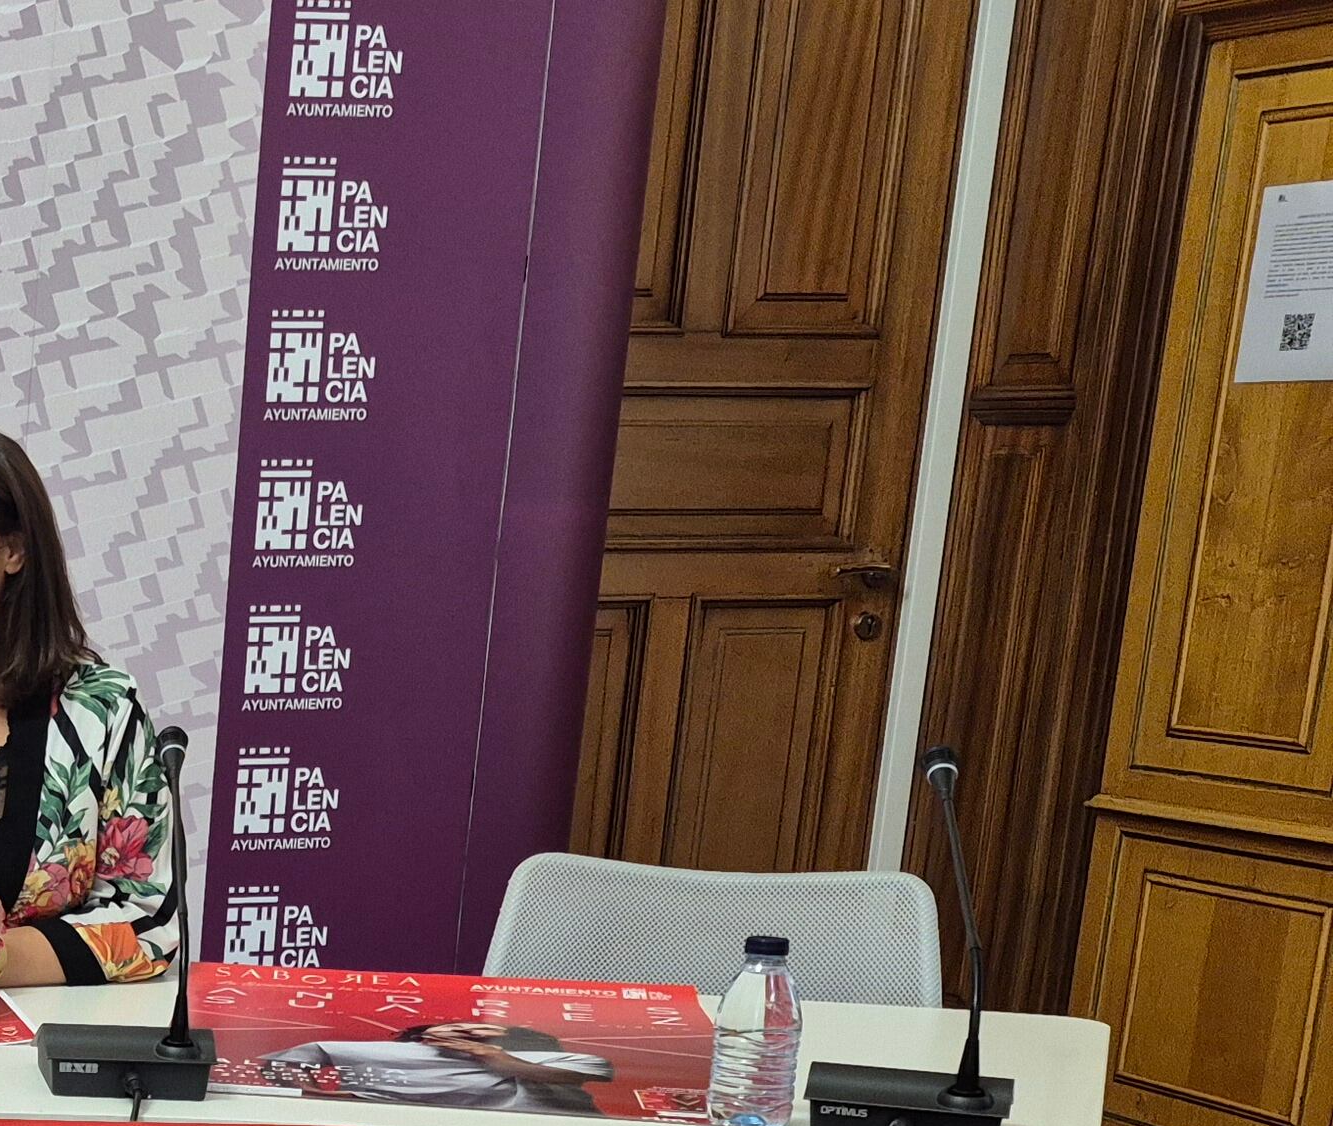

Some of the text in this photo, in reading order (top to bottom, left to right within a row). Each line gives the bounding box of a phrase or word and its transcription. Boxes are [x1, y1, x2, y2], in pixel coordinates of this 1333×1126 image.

[355, 25, 388, 48] PA
[353, 50, 404, 74] LEN
[350, 76, 394, 99] CIA
[287, 103, 393, 118] AYUNTAMIENTO
[341, 181, 373, 203] PA
[338, 205, 388, 229] LEN
[336, 230, 380, 252] CIA
[275, 258, 379, 272] AYUNTAMIENTO
[329, 332, 361, 355] PA
[327, 356, 375, 379] LEN
[324, 381, 368, 403] CIA
[263, 408, 367, 421] AYUNTAMIENTO
[316, 481, 349, 502] PA
[314, 504, 363, 526] LEN
[313, 528, 355, 550] CIA
[252, 554, 354, 568] AYUNTAMIENTO
[305, 626, 336, 647] PA
[303, 648, 351, 670] LEN
[301, 671, 343, 693] CIA
[241, 697, 343, 712] AYUNTAMIENTO
[294, 767, 325, 788] PA
[292, 789, 339, 811] LEN
[290, 812, 332, 832] CIA
[231, 836, 331, 851] AYUNTAMIENTO
[283, 905, 314, 925] PA
[281, 926, 328, 947] LEN
[279, 948, 321, 968] CIA
[470, 984, 617, 997] AYUNTAMIENTO
[820, 1105, 868, 1118] OPTIMUS
